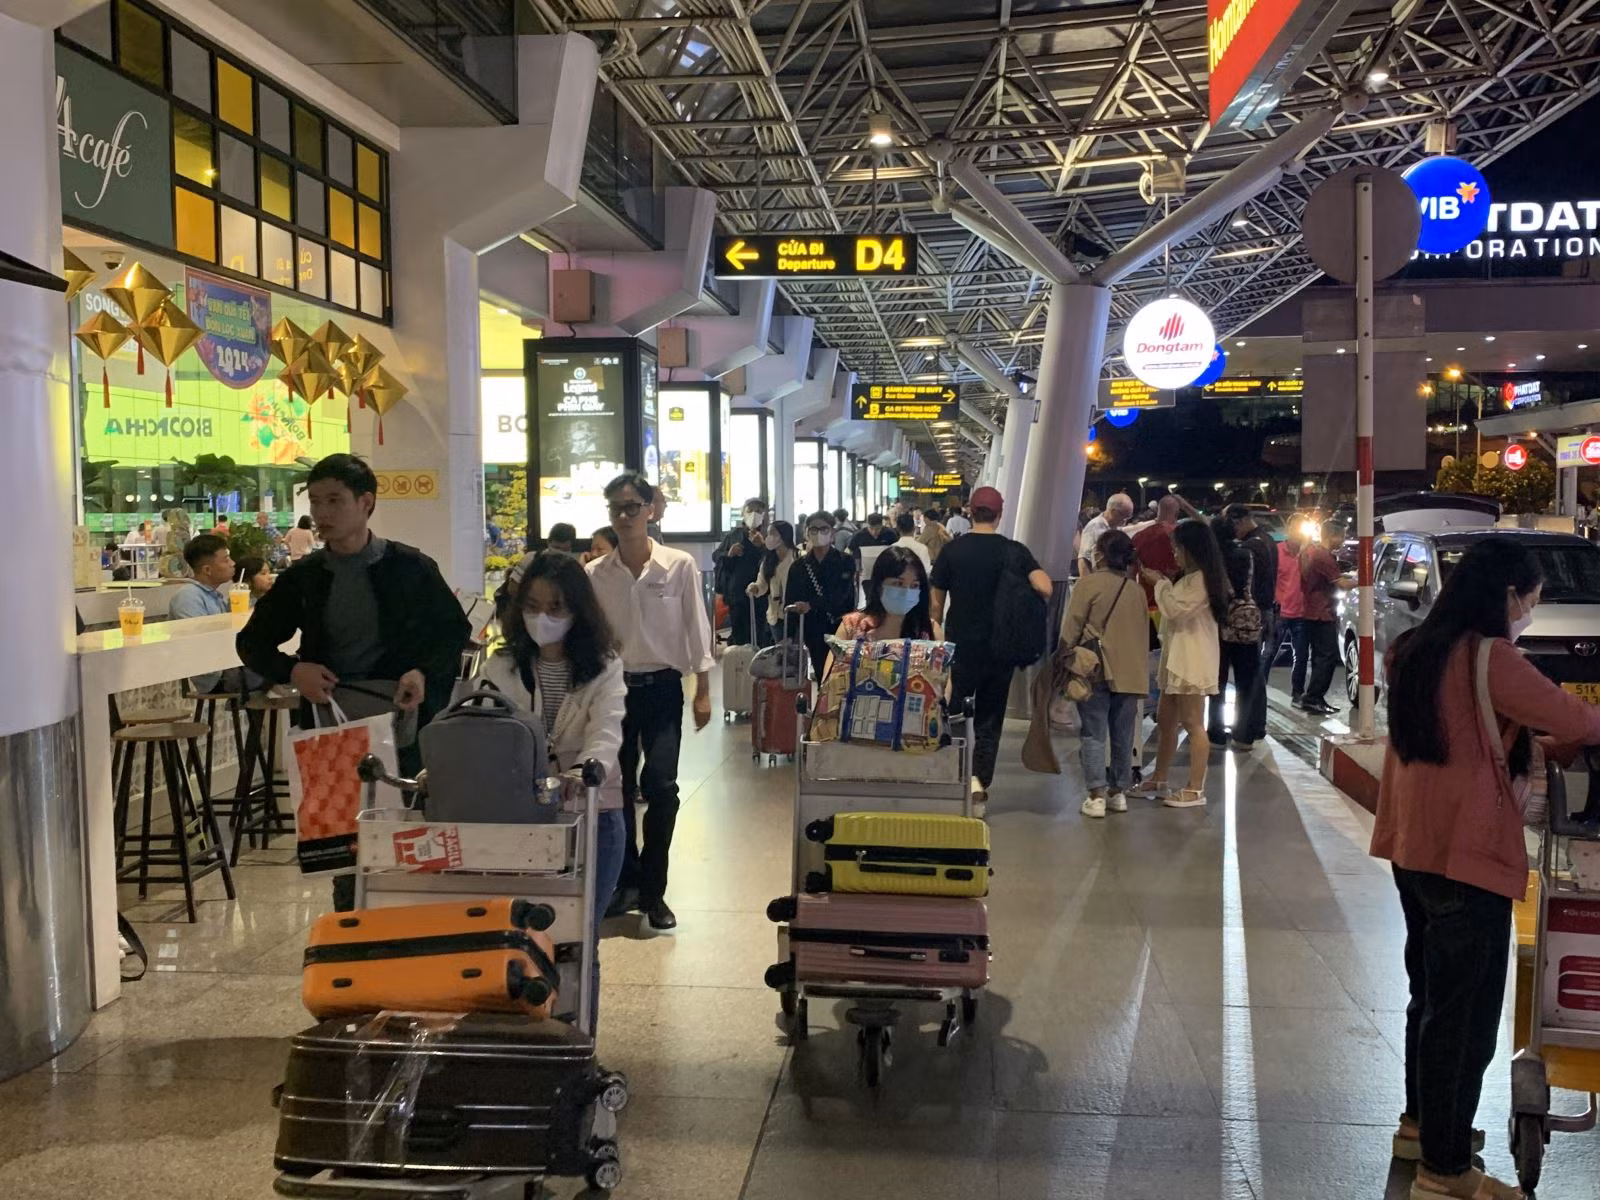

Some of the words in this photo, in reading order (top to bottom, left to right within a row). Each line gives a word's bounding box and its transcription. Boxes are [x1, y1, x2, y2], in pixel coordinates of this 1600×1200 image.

[75, 111, 148, 209] café
[1487, 200, 1600, 232] TDAT
[778, 239, 808, 256] CỬA
[809, 242, 824, 255] ĐI
[856, 239, 906, 271] D4
[778, 258, 836, 272] Departure
[1136, 342, 1203, 355] Dongtam
[216, 345, 250, 377] 2024
[497, 414, 529, 433] BO
[1575, 684, 1598, 695] 51K
